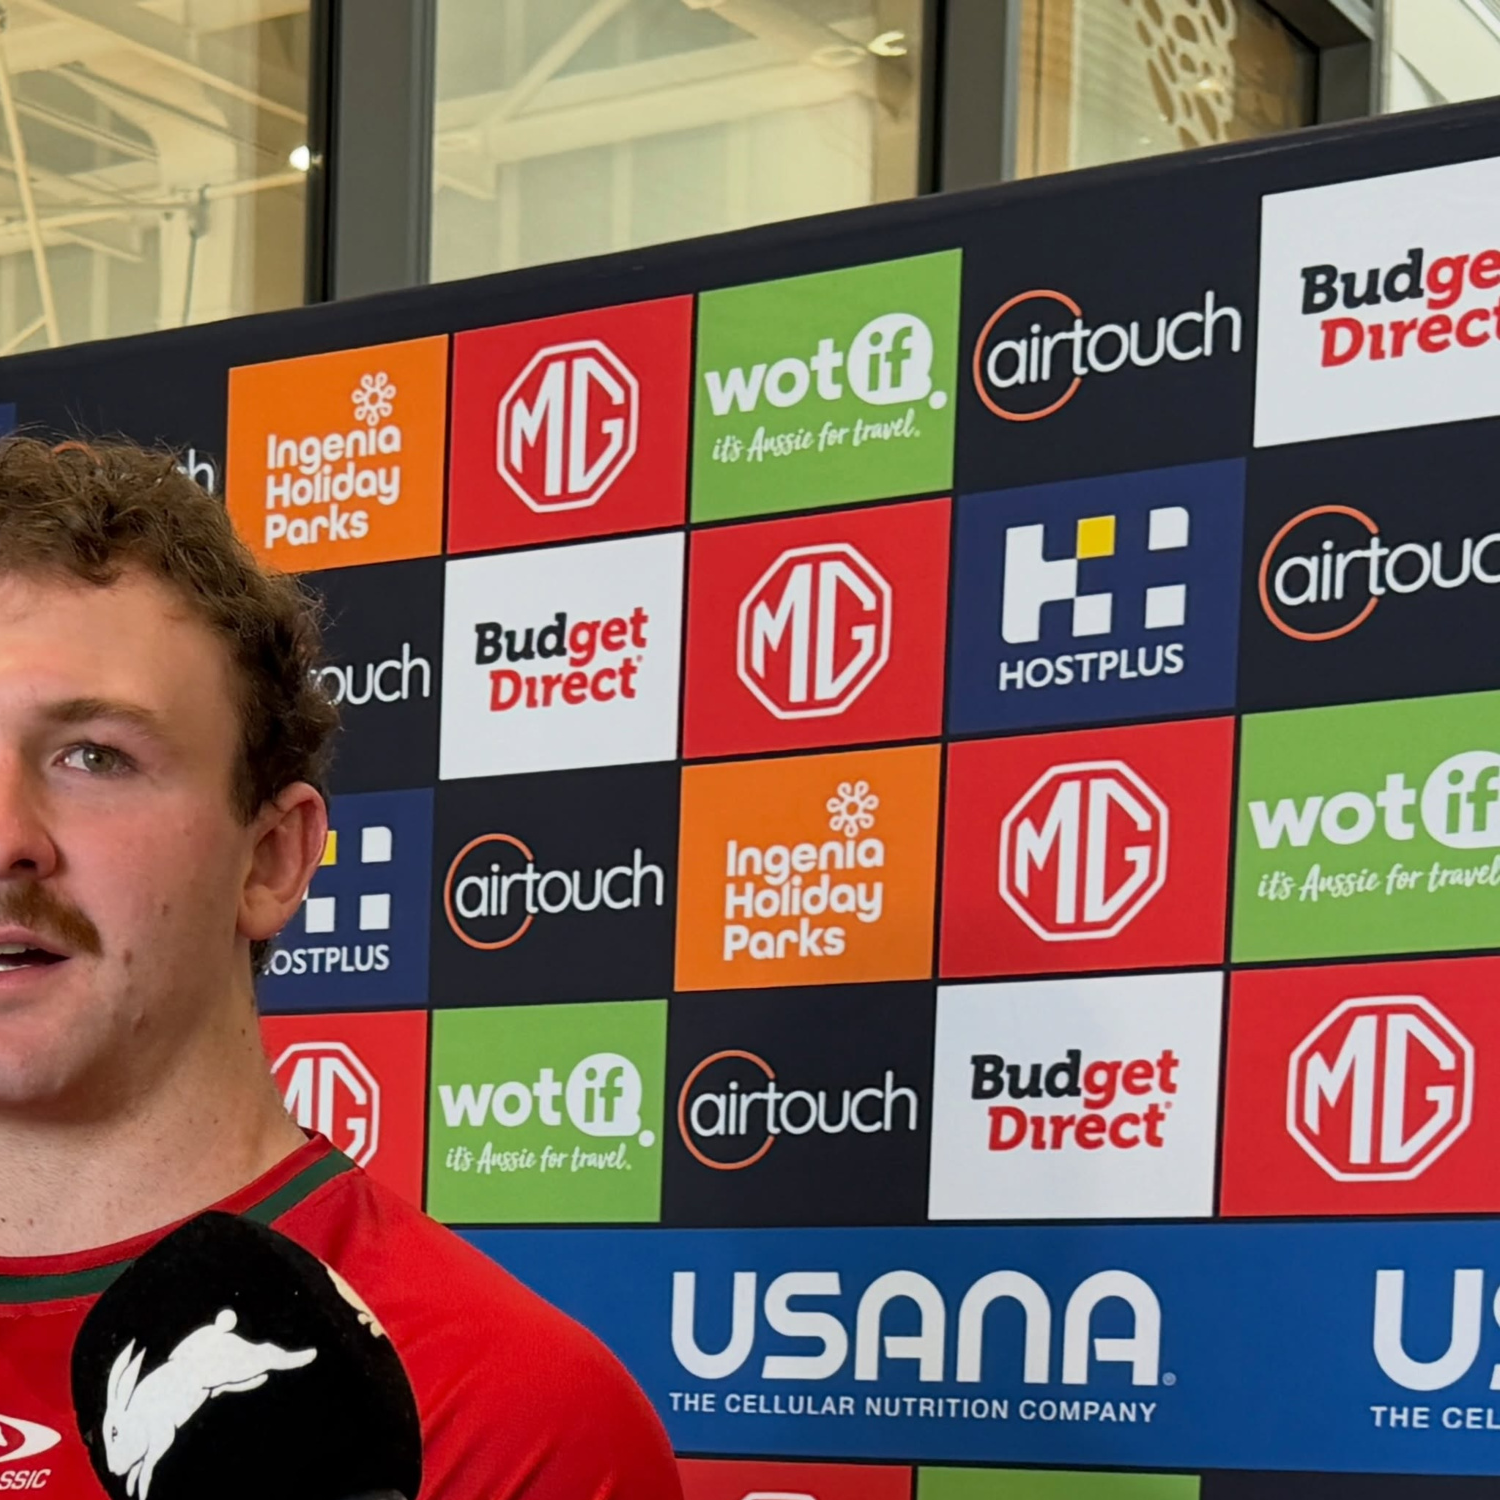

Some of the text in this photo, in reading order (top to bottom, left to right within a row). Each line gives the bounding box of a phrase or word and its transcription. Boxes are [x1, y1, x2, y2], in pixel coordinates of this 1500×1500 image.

[1300, 246, 1500, 314] Budge
[986, 290, 1242, 388] airtouch
[265, 425, 402, 474] Ingenia
[747, 424, 812, 462] Aussie
[816, 422, 849, 453] for
[264, 463, 401, 510] Holiday
[264, 507, 369, 549] Parks
[1273, 532, 1500, 606] airtouc
[473, 606, 649, 668] Budget
[311, 642, 430, 706] ouch
[488, 657, 639, 712] Direct
[998, 643, 1185, 692] HOSTPLUS
[455, 848, 665, 920] airtouch
[726, 837, 884, 886] Ingenia
[1299, 862, 1382, 902] Aussie
[1386, 862, 1424, 896] for
[725, 879, 883, 924] Holiday
[264, 943, 391, 976] OSTPLUS
[723, 922, 846, 962] Parks
[689, 1069, 917, 1137] airtouch
[970, 1048, 1179, 1109] Budget
[987, 1100, 1167, 1152] Direct
[476, 1141, 536, 1174] Aussie
[540, 1143, 569, 1173] for
[670, 1269, 1162, 1388] USANA
[668, 1392, 1158, 1425] THE CELLULAR NUTRITION COMPANY
[1370, 1405, 1431, 1429] THE
